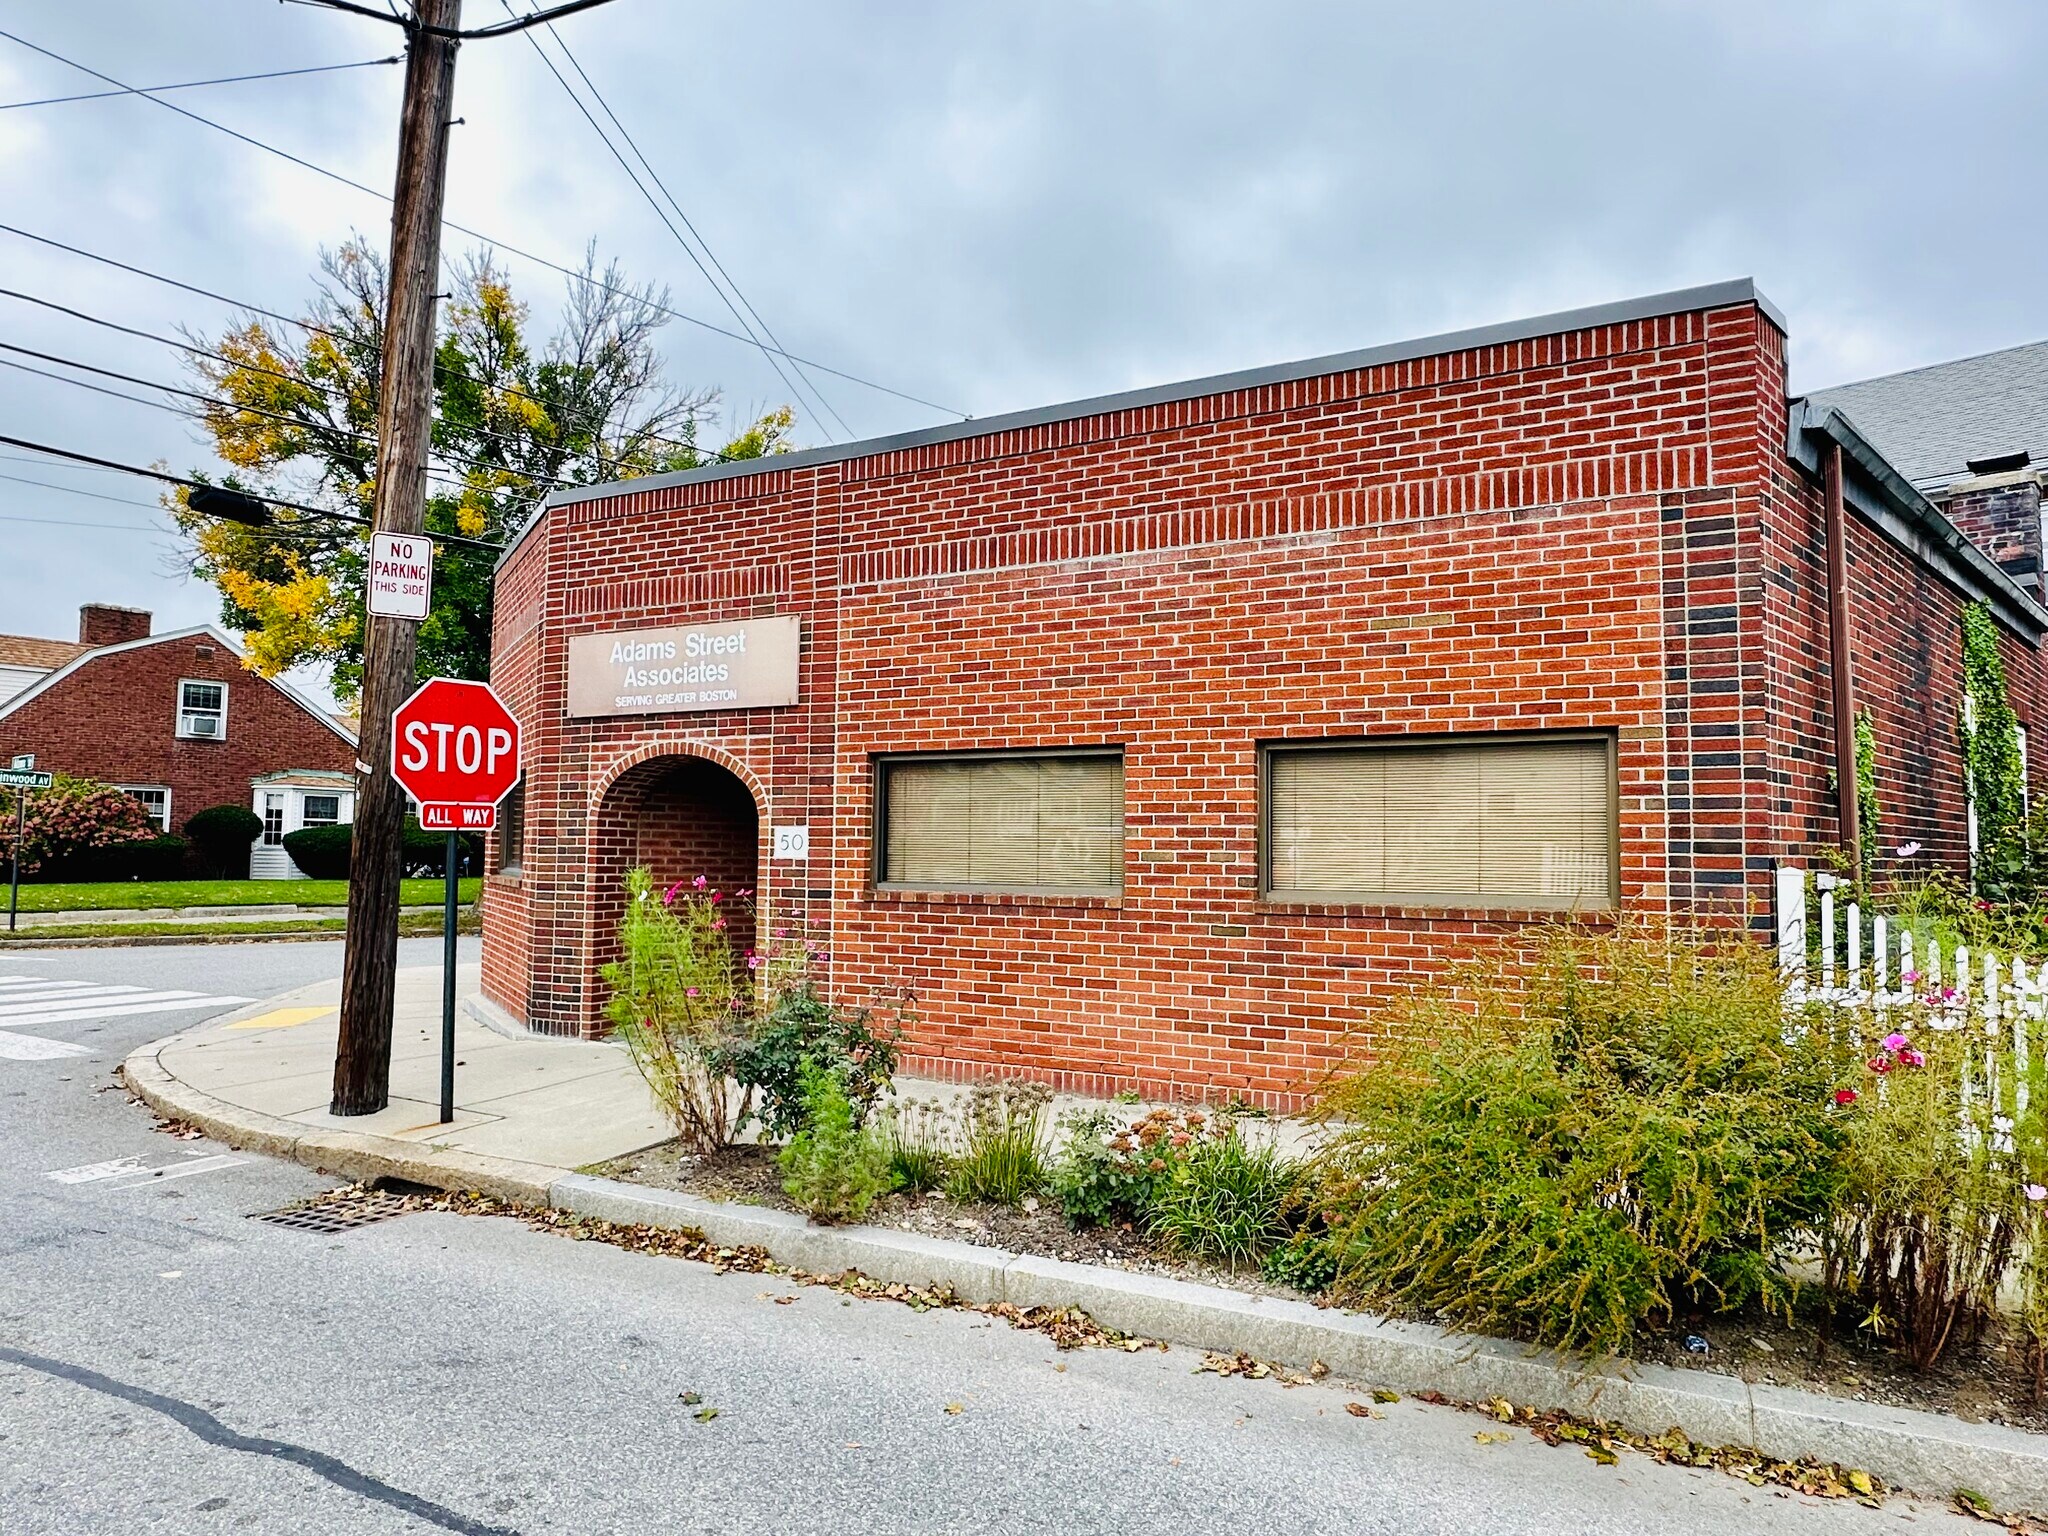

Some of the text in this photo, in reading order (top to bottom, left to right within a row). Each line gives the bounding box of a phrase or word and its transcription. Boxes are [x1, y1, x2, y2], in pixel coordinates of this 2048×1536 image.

[390, 542, 413, 559] NO
[374, 561, 426, 581] PARKING
[374, 580, 425, 596] THIS SIDE
[609, 628, 747, 664] Adams Street
[623, 661, 729, 688] Associates
[614, 689, 738, 708] SERVING GREATER BOSTON
[401, 720, 513, 775] STOP
[38, 776, 49, 785] AV
[426, 807, 490, 825] ALL WAY
[780, 833, 804, 851] 50
